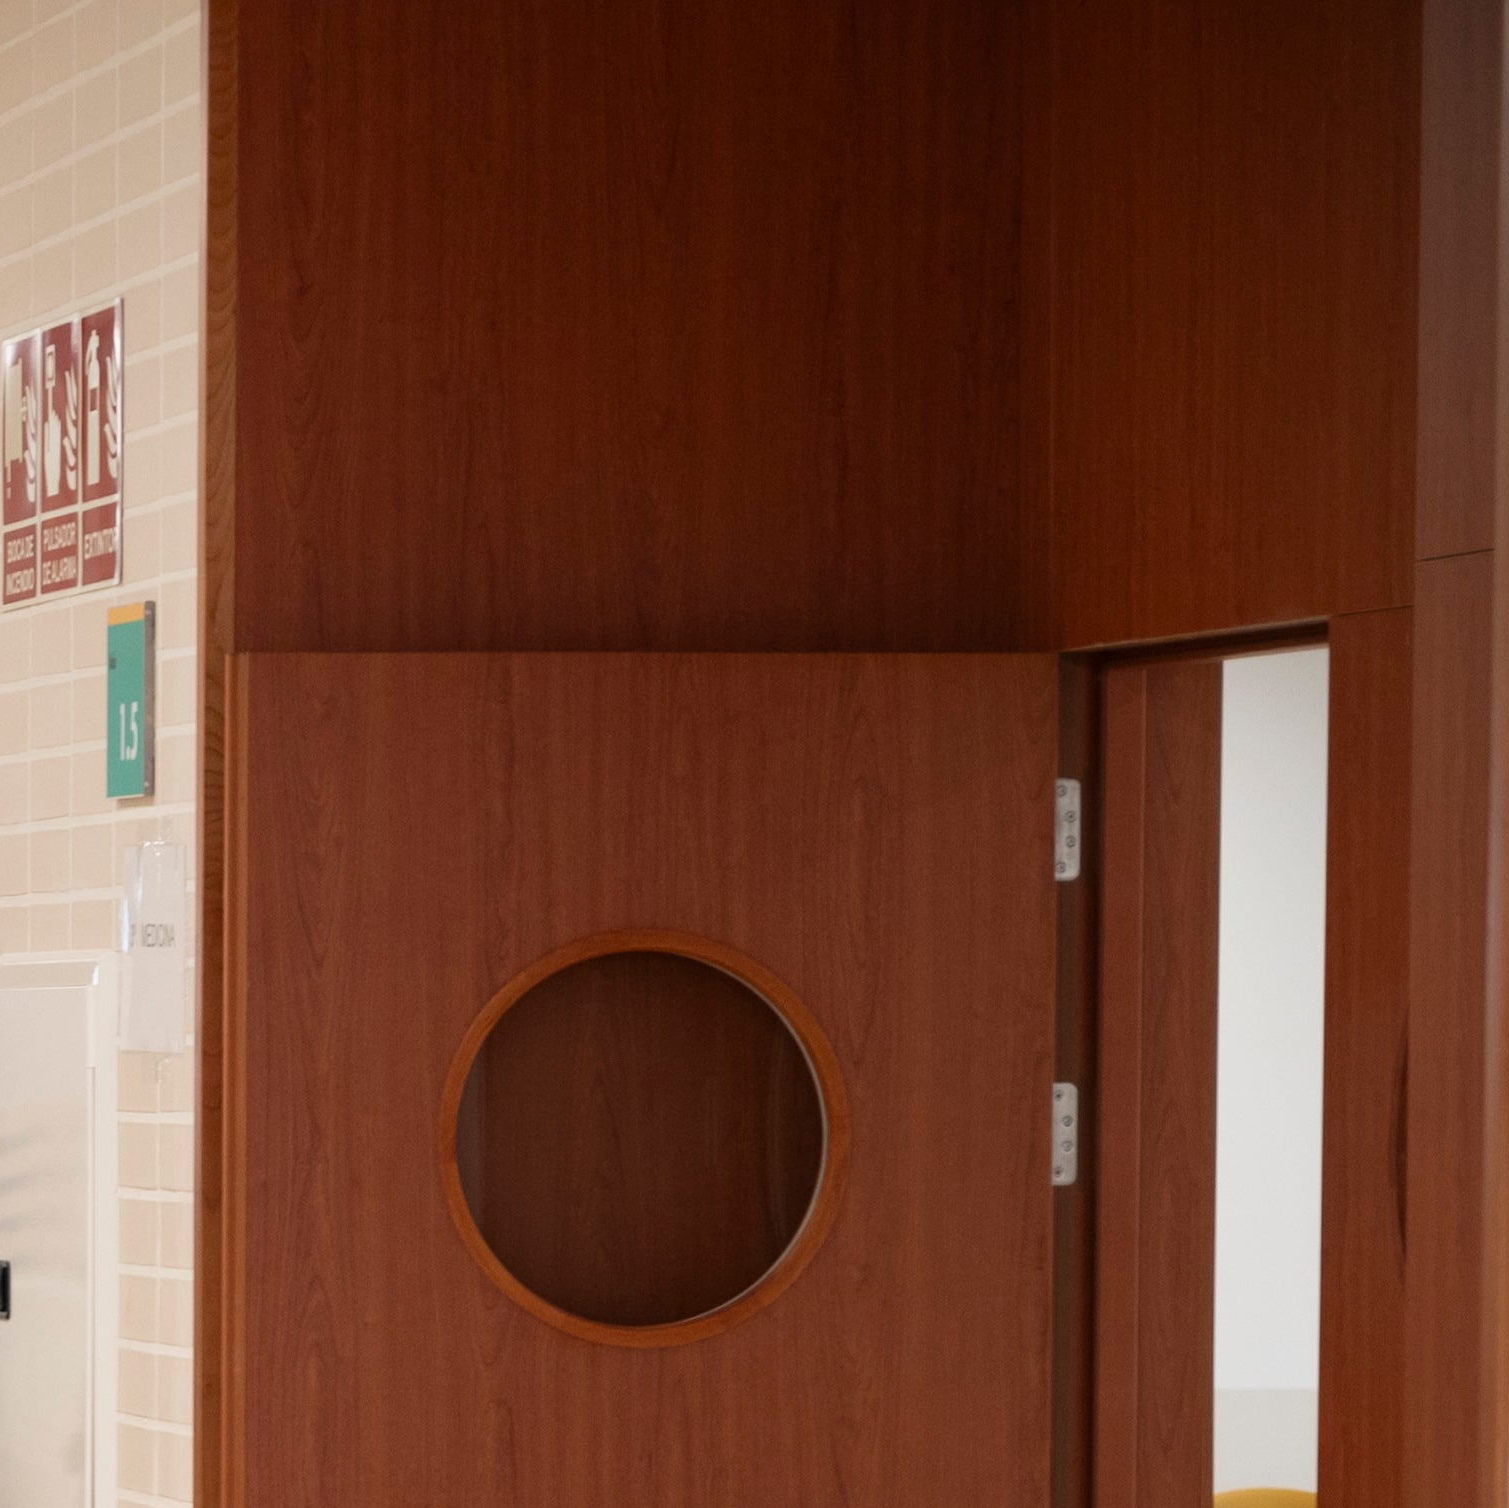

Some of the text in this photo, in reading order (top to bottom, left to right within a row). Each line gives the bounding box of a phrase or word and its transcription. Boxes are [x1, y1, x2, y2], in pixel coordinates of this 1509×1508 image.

[7, 534, 34, 563] BOCA DE
[43, 521, 76, 551] PULSADOR
[6, 566, 35, 596] INCENDIO
[42, 554, 76, 586] DE ALARMA
